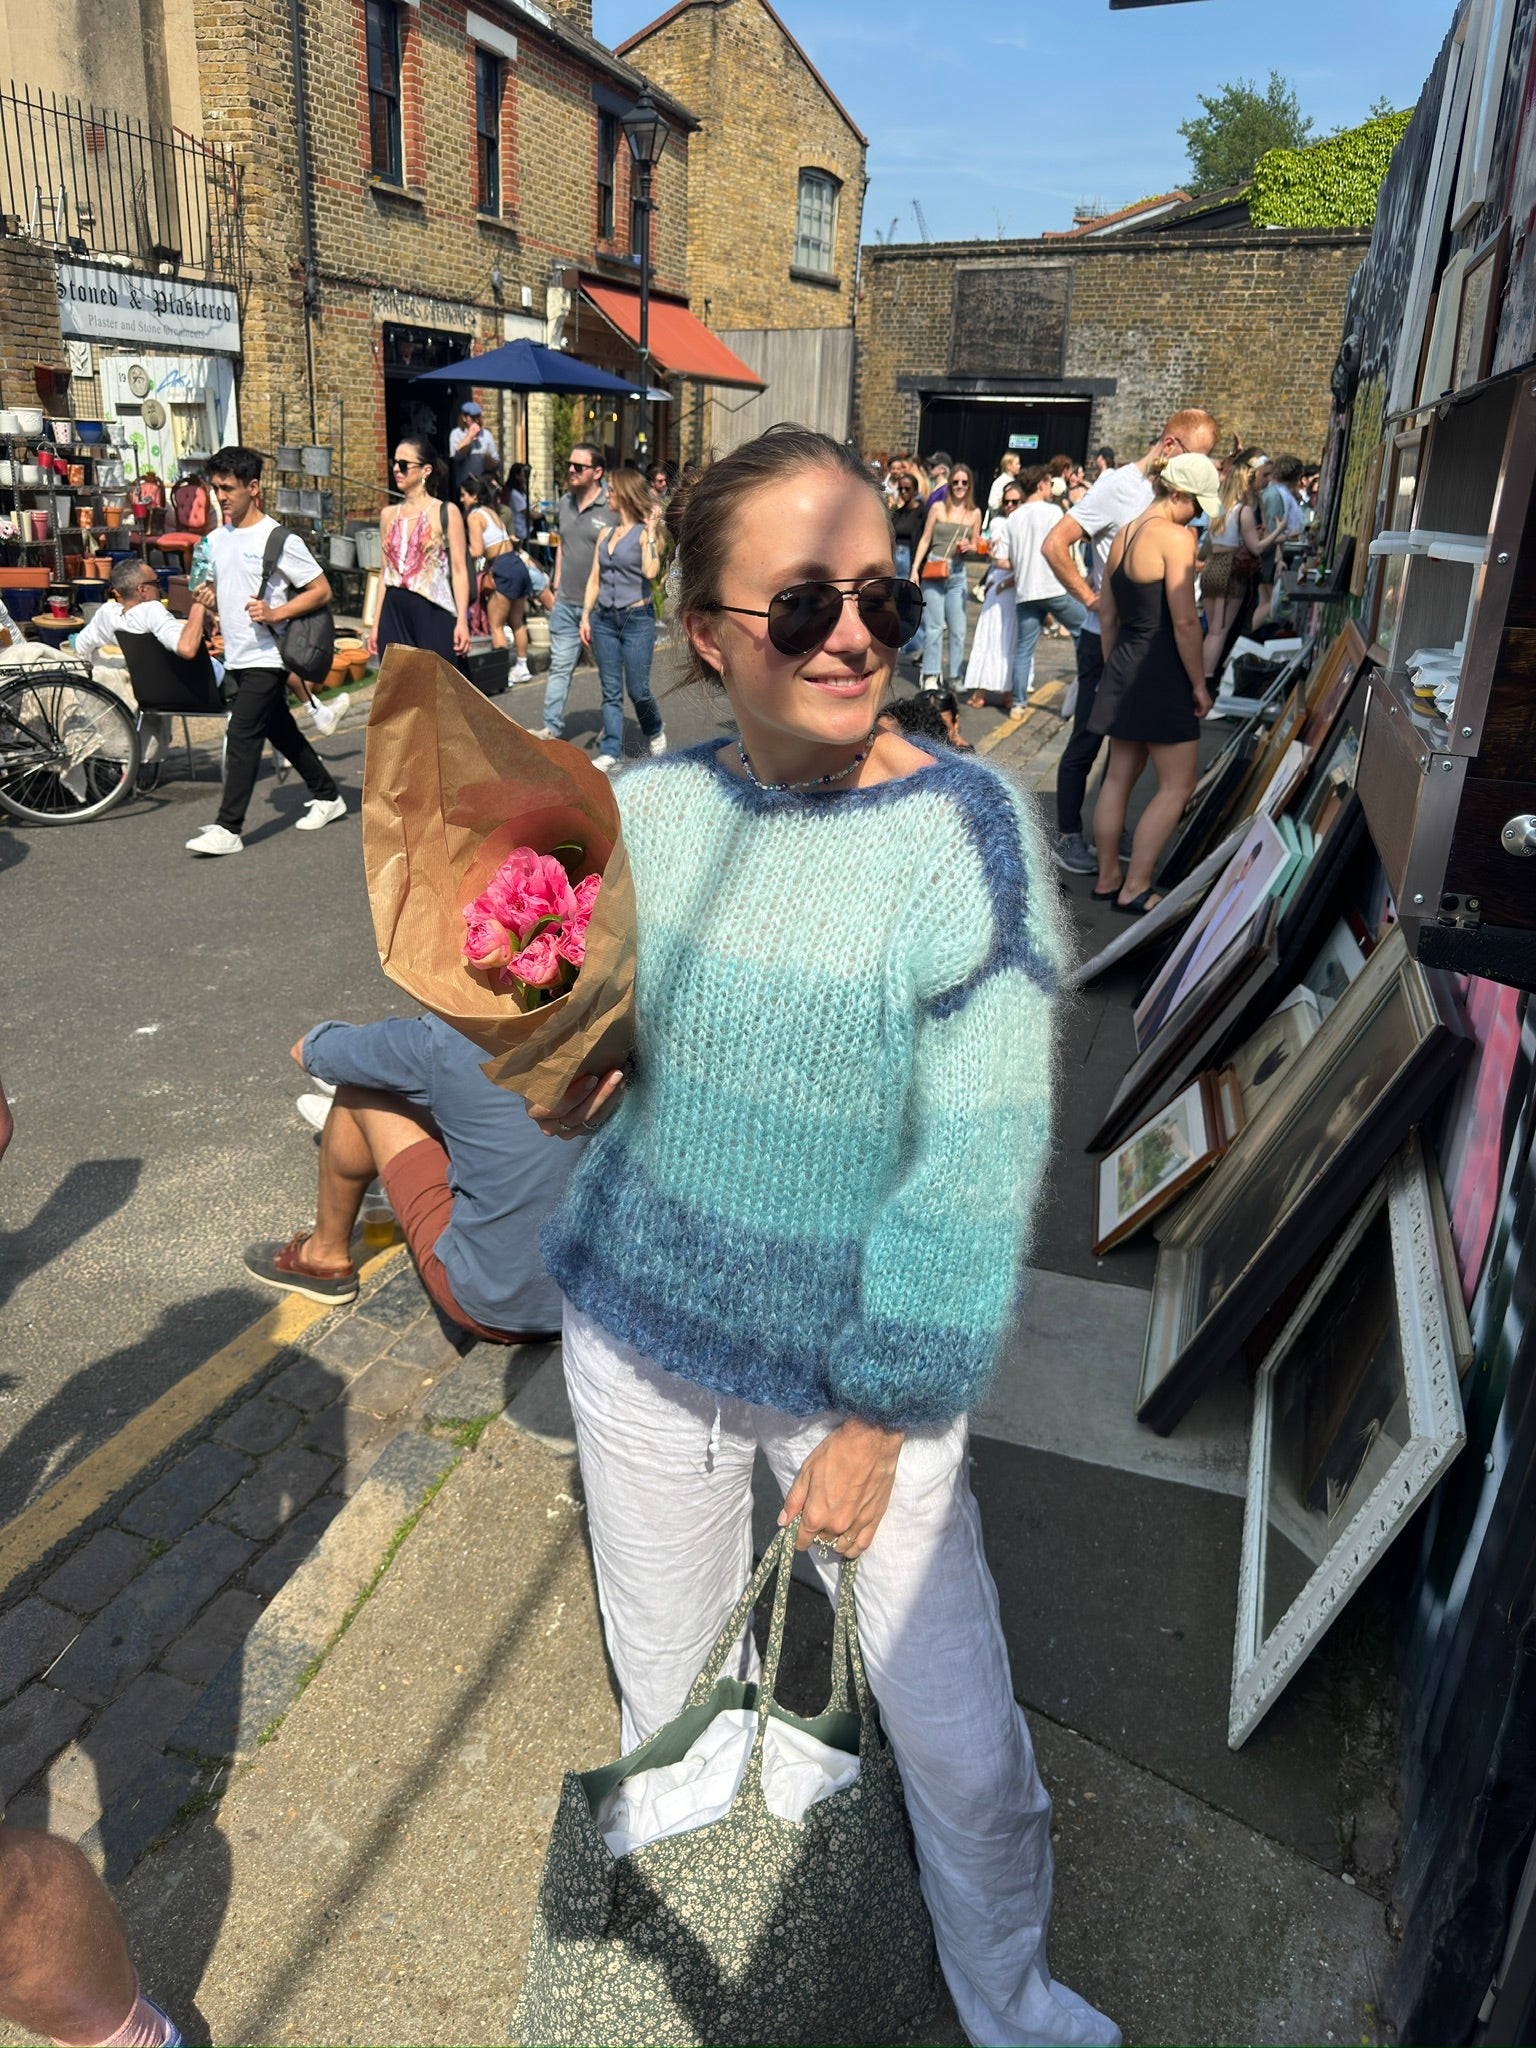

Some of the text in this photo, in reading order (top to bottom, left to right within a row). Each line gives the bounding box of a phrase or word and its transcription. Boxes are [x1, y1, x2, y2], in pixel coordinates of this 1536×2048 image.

[129, 289, 144, 311] &
[153, 288, 232, 323] Plastered
[88, 313, 119, 330] Plaster
[120, 319, 137, 332] and
[138, 321, 162, 335] Stone
